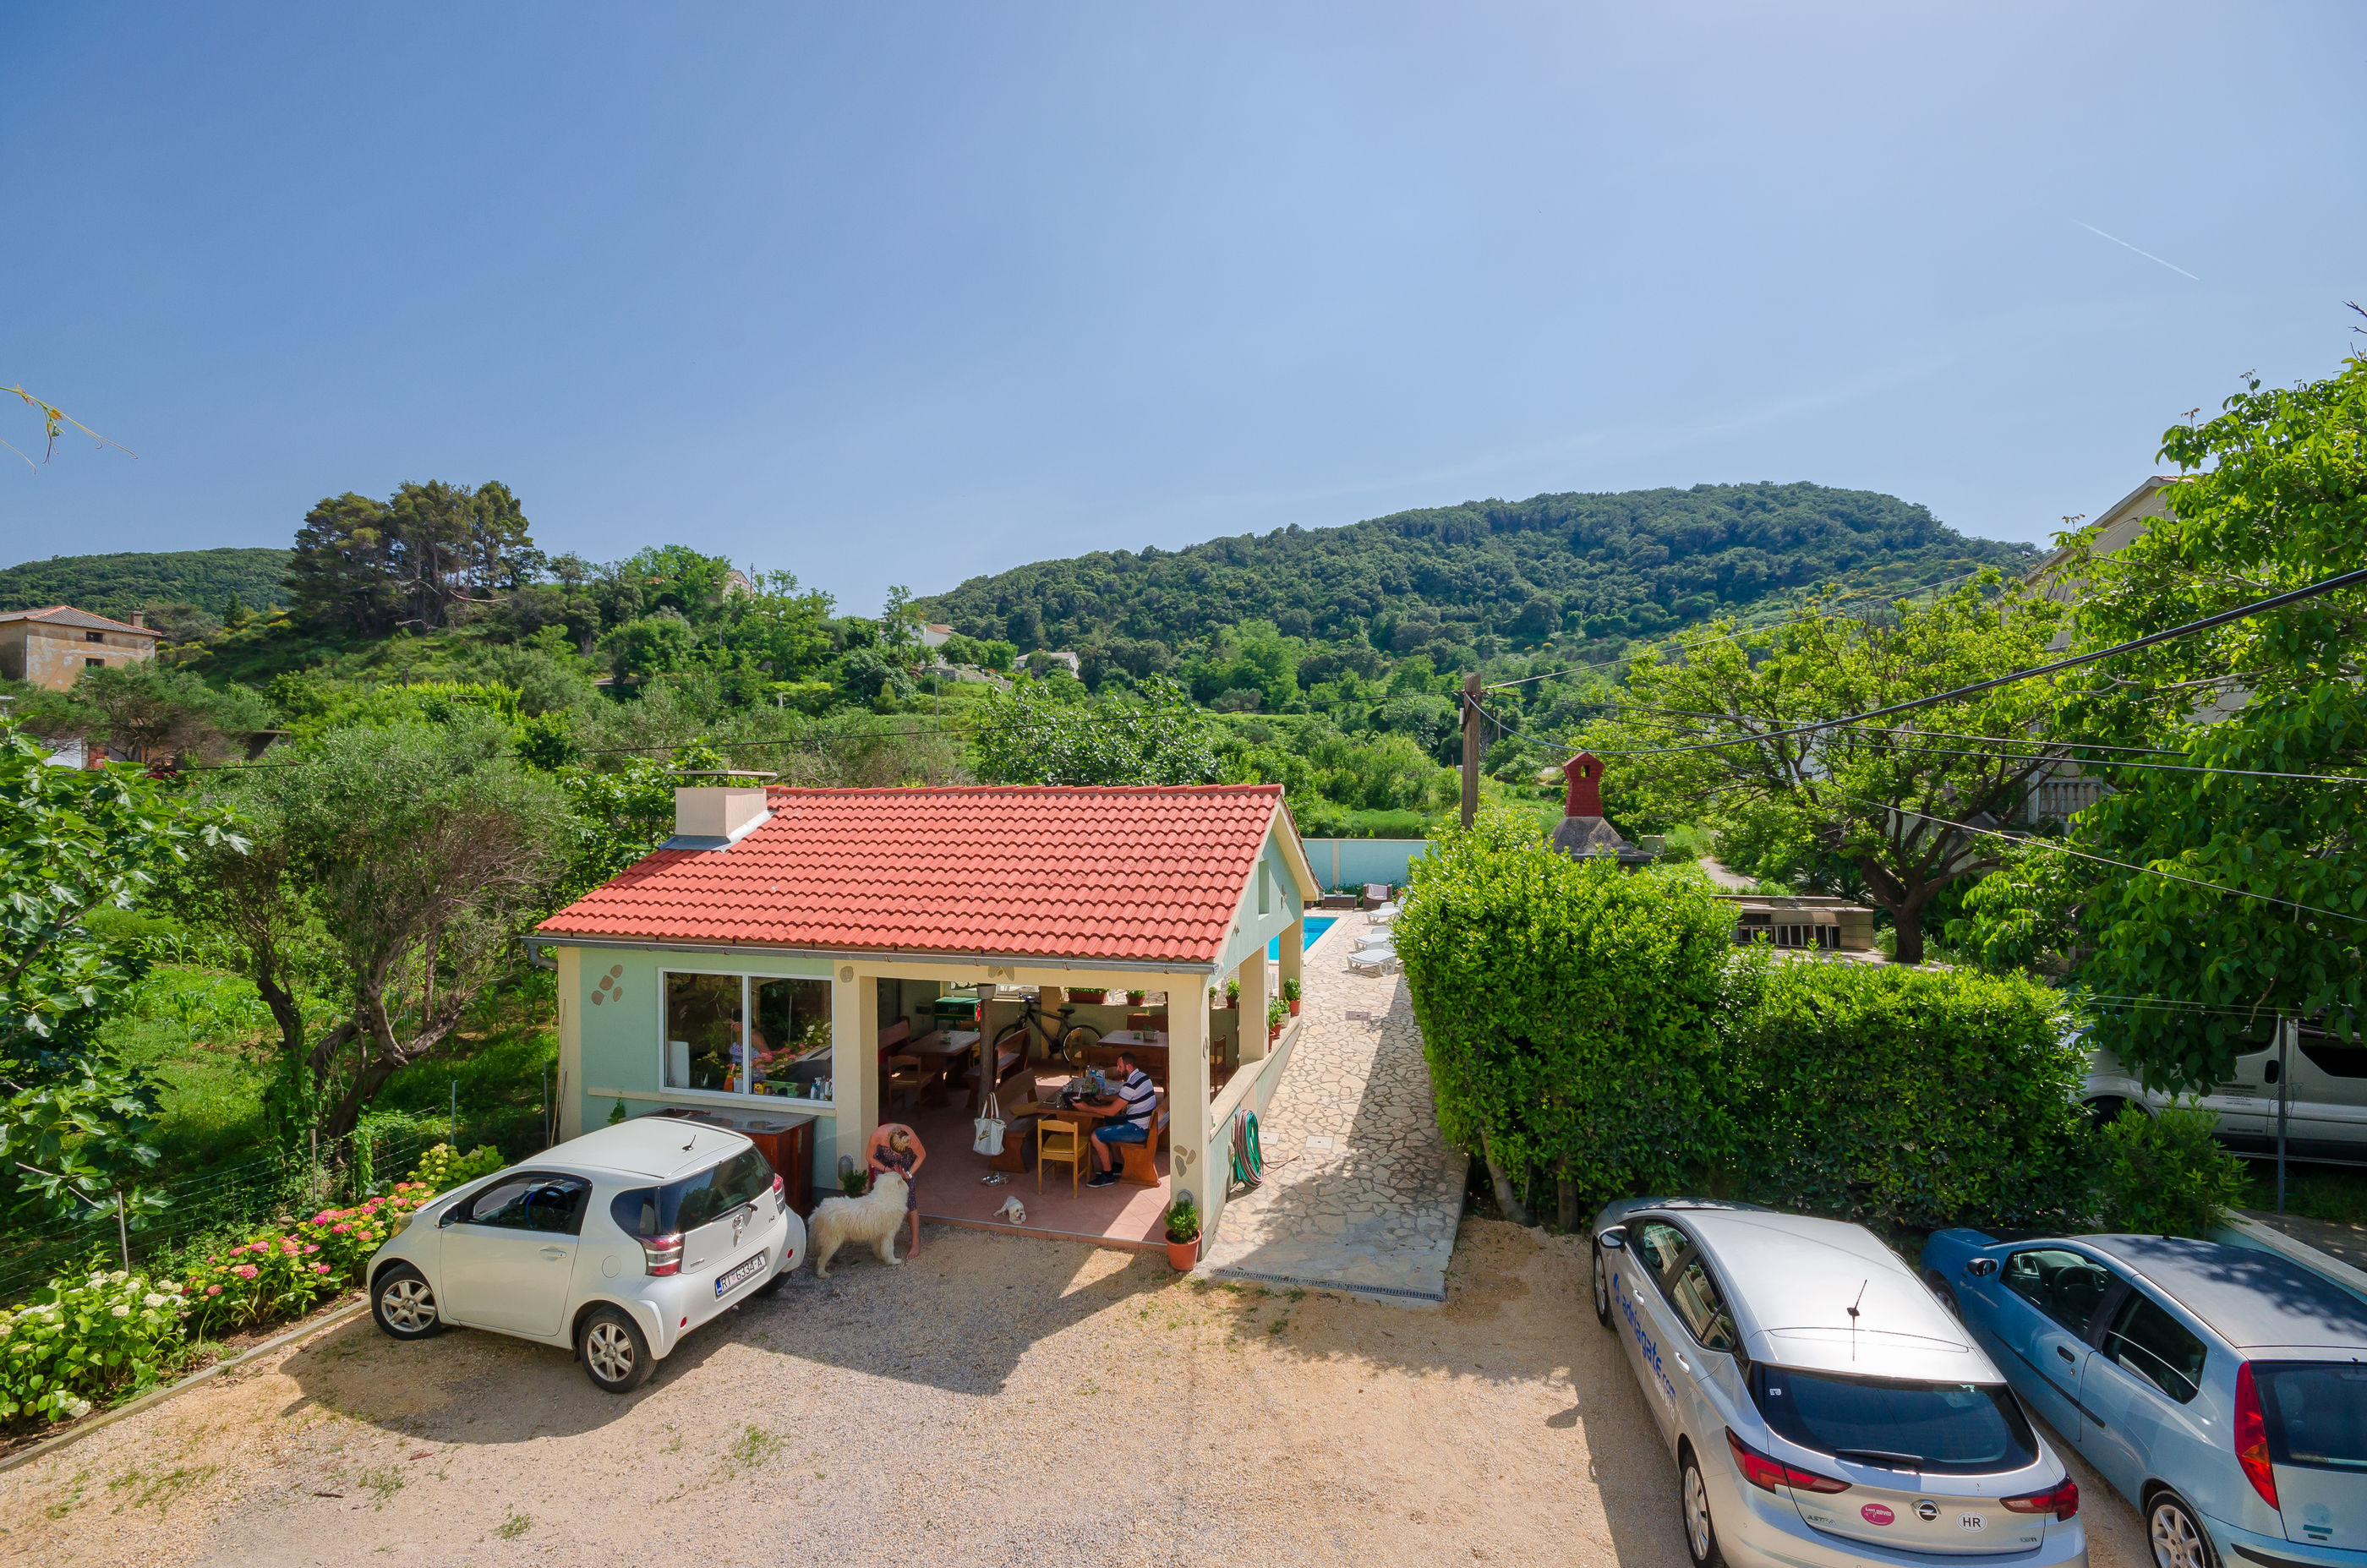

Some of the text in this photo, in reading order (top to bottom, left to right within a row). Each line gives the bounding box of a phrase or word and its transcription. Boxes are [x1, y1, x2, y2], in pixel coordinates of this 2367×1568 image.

[721, 1256, 763, 1290] RI 6334-A
[1962, 1516, 1982, 1528] HR
